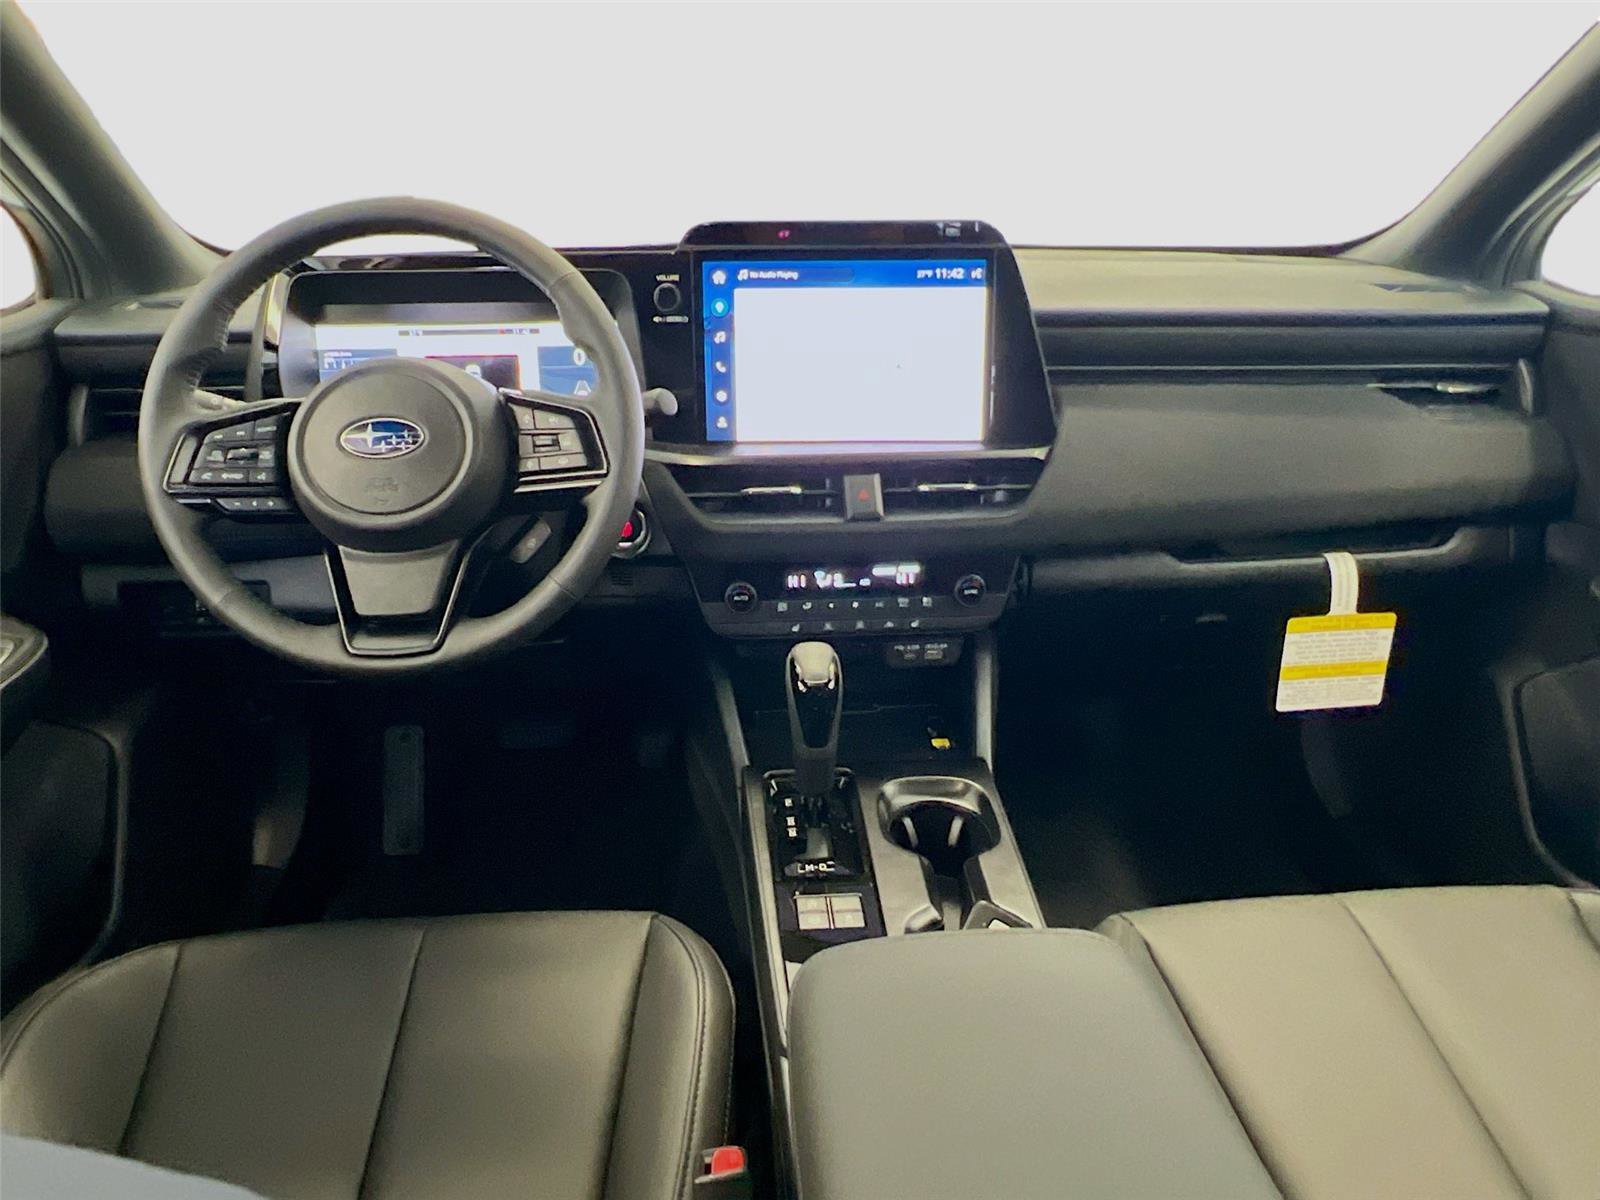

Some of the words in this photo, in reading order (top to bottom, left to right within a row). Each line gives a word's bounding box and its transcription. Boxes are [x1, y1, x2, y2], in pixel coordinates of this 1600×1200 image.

[759, 271, 776, 279] Audio
[777, 271, 798, 281] Playing
[936, 268, 964, 279] 11:42
